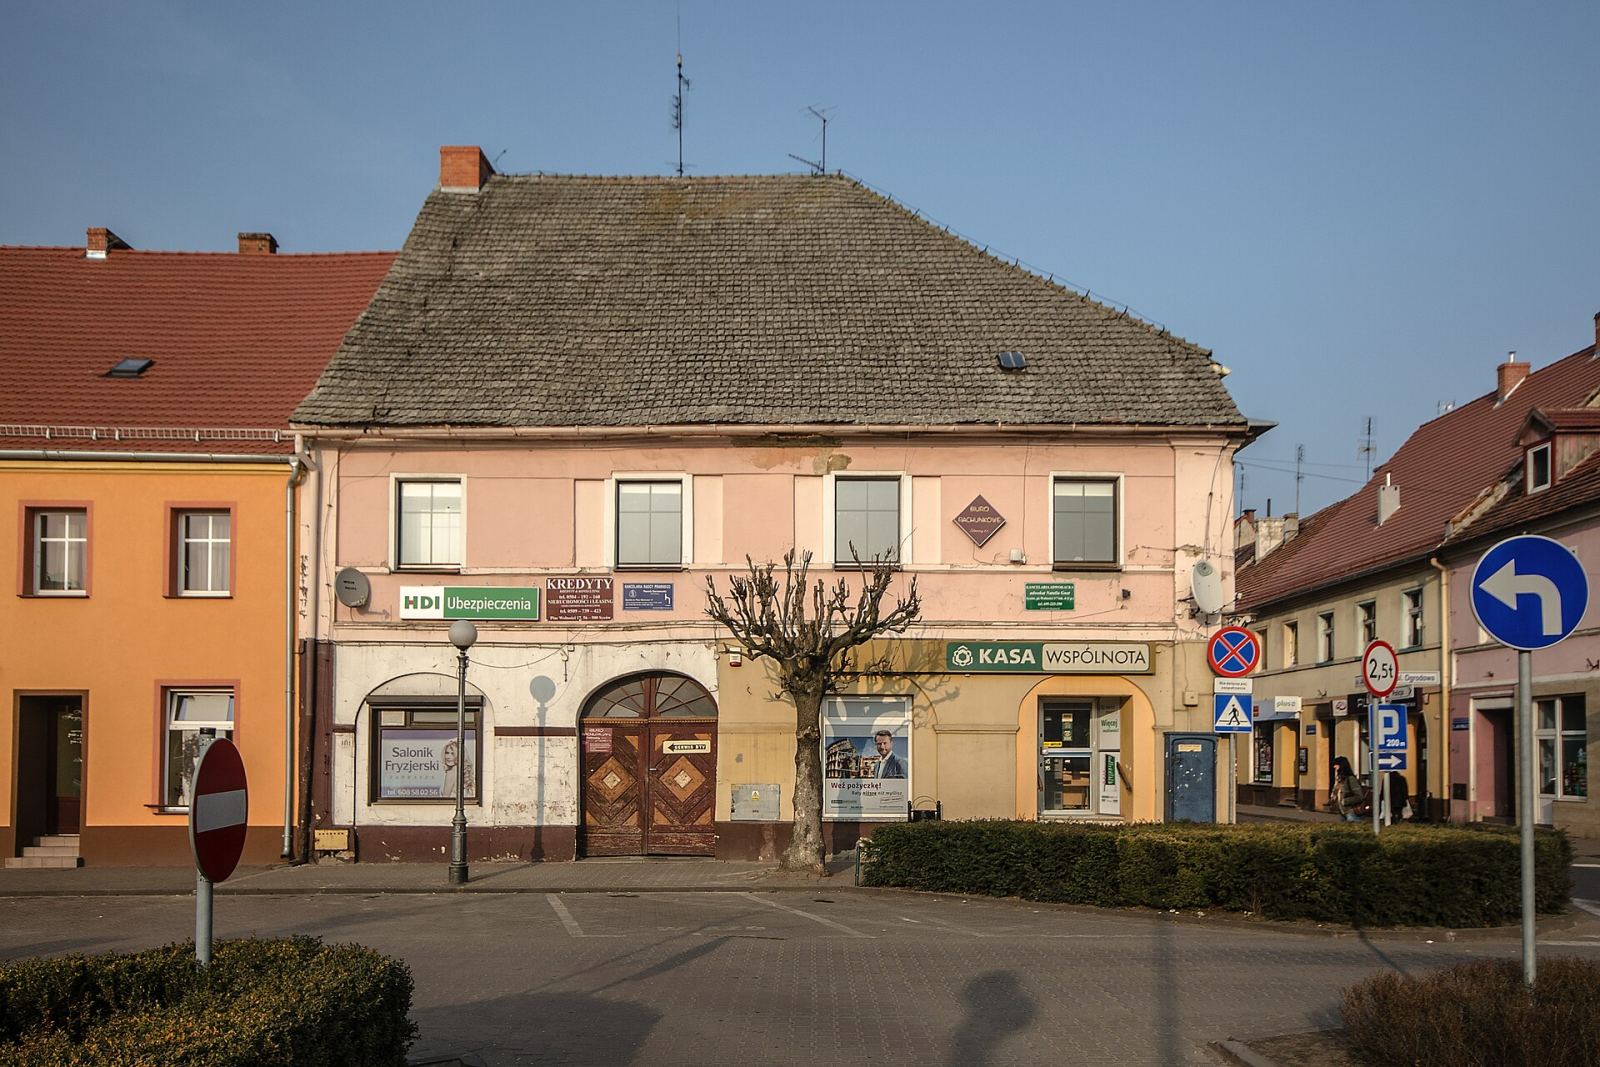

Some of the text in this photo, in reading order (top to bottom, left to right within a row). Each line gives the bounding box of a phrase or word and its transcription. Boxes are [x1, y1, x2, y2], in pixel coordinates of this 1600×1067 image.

[547, 578, 613, 589] KREDYTY
[404, 595, 531, 612] HDI Ubezpieczenia
[979, 647, 1146, 664] KASA WSPÓLNOTA
[1369, 658, 1394, 681] 2,5t
[1377, 709, 1400, 745] P
[392, 747, 434, 758] Salonik
[385, 760, 440, 773] Fryzjerski
[847, 782, 882, 790] pożyczkę!
